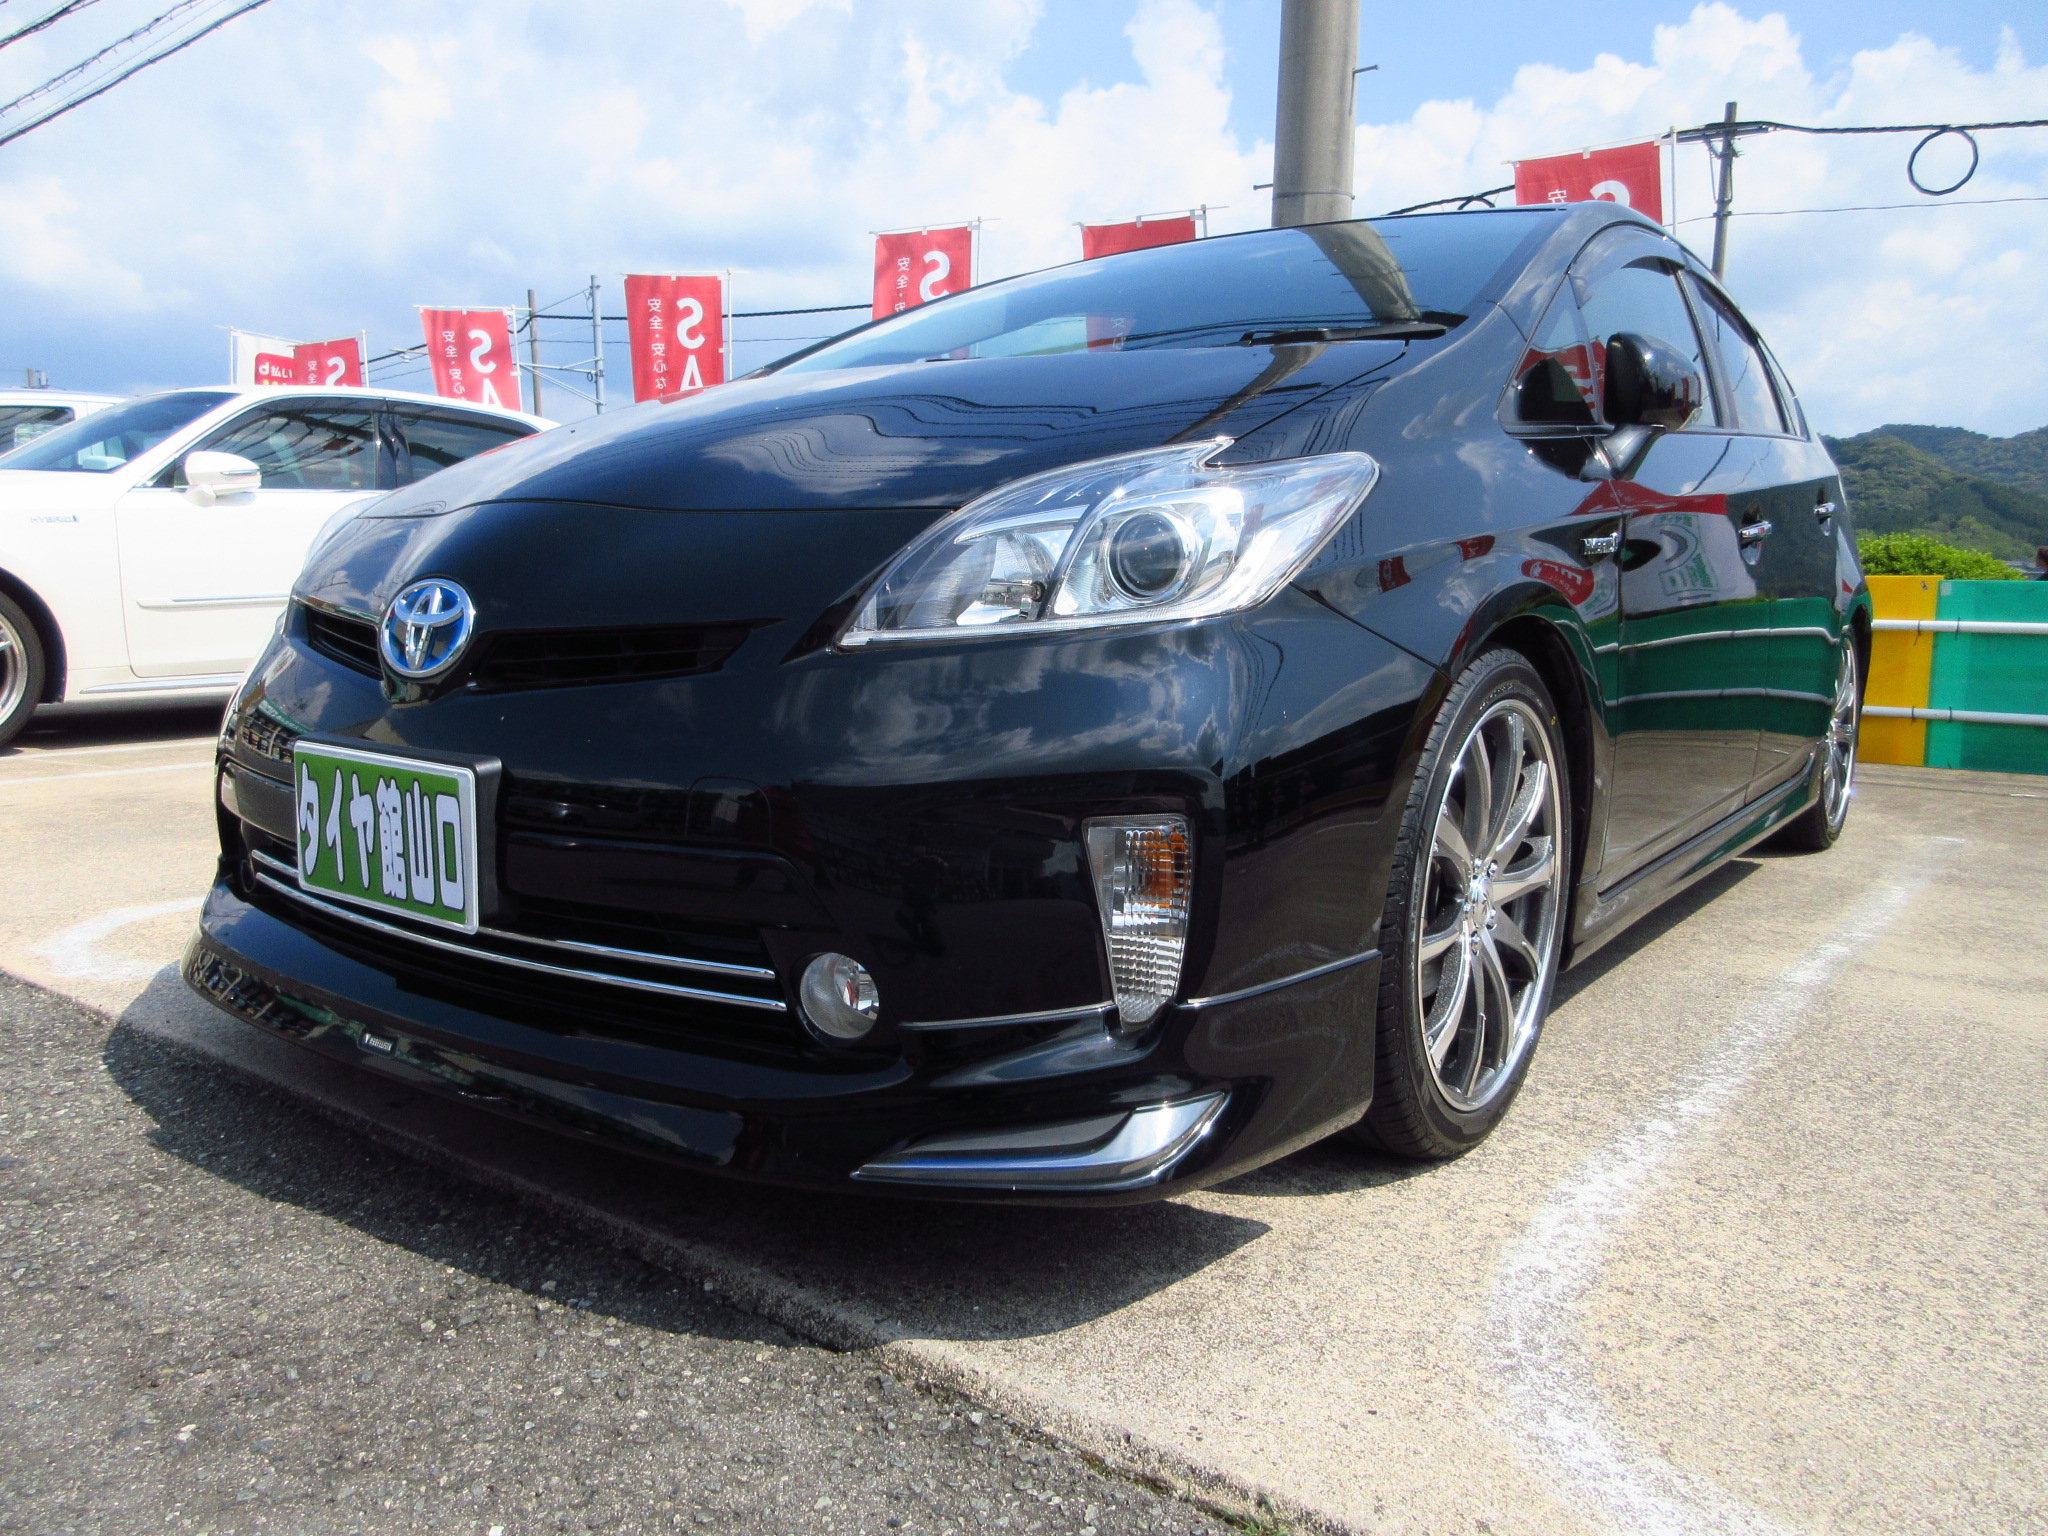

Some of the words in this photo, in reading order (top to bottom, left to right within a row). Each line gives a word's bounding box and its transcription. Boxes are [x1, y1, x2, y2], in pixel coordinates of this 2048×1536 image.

[299, 760, 466, 912] タイヤ館山口
